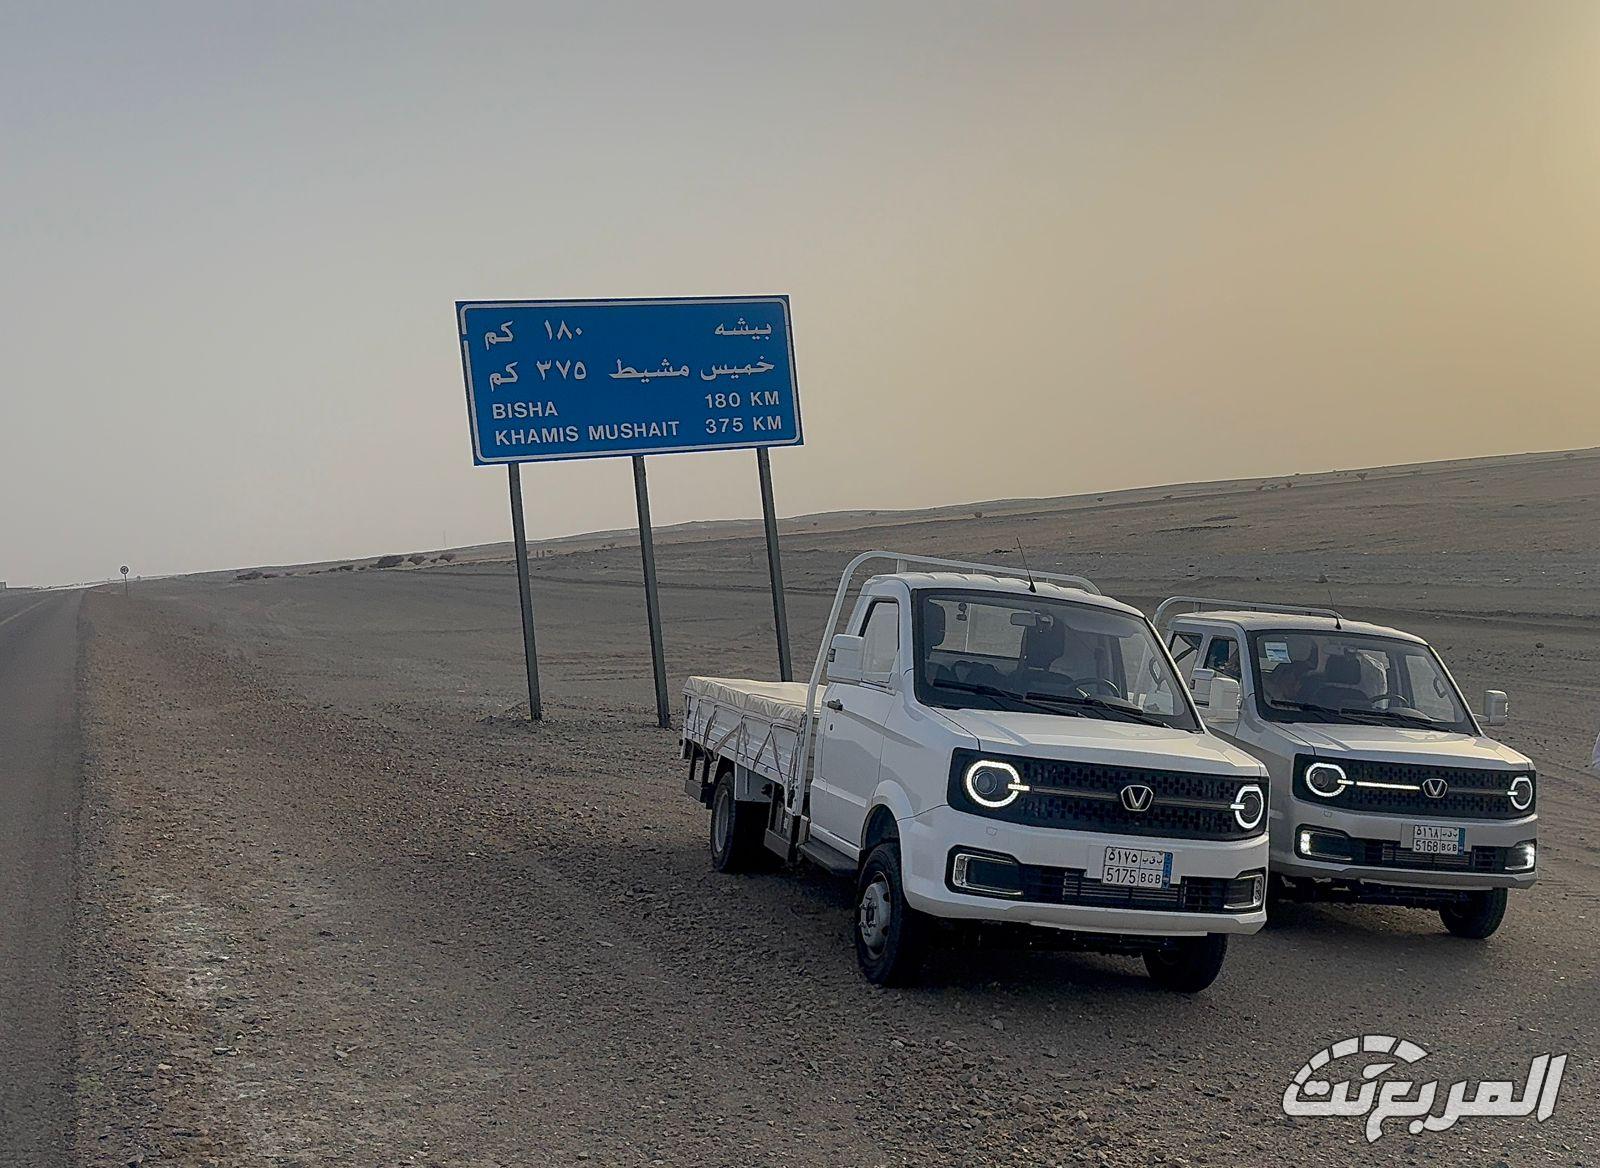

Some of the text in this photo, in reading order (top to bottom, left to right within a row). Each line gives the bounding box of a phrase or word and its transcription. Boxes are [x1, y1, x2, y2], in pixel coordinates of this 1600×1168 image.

[484, 320, 514, 351] كم
[544, 318, 583, 341] ١٨٠
[489, 355, 776, 392] خميس مشيط ٣٧٥ كم
[491, 390, 780, 420] BISHA 180 KM
[495, 415, 782, 446] KHAMIS MUSHAIT 375 KM
[1108, 850, 1138, 865] ٥١٧٥
[1415, 840, 1439, 852] 5168
[1106, 867, 1136, 884] 5175
[1140, 872, 1162, 884] BGB
